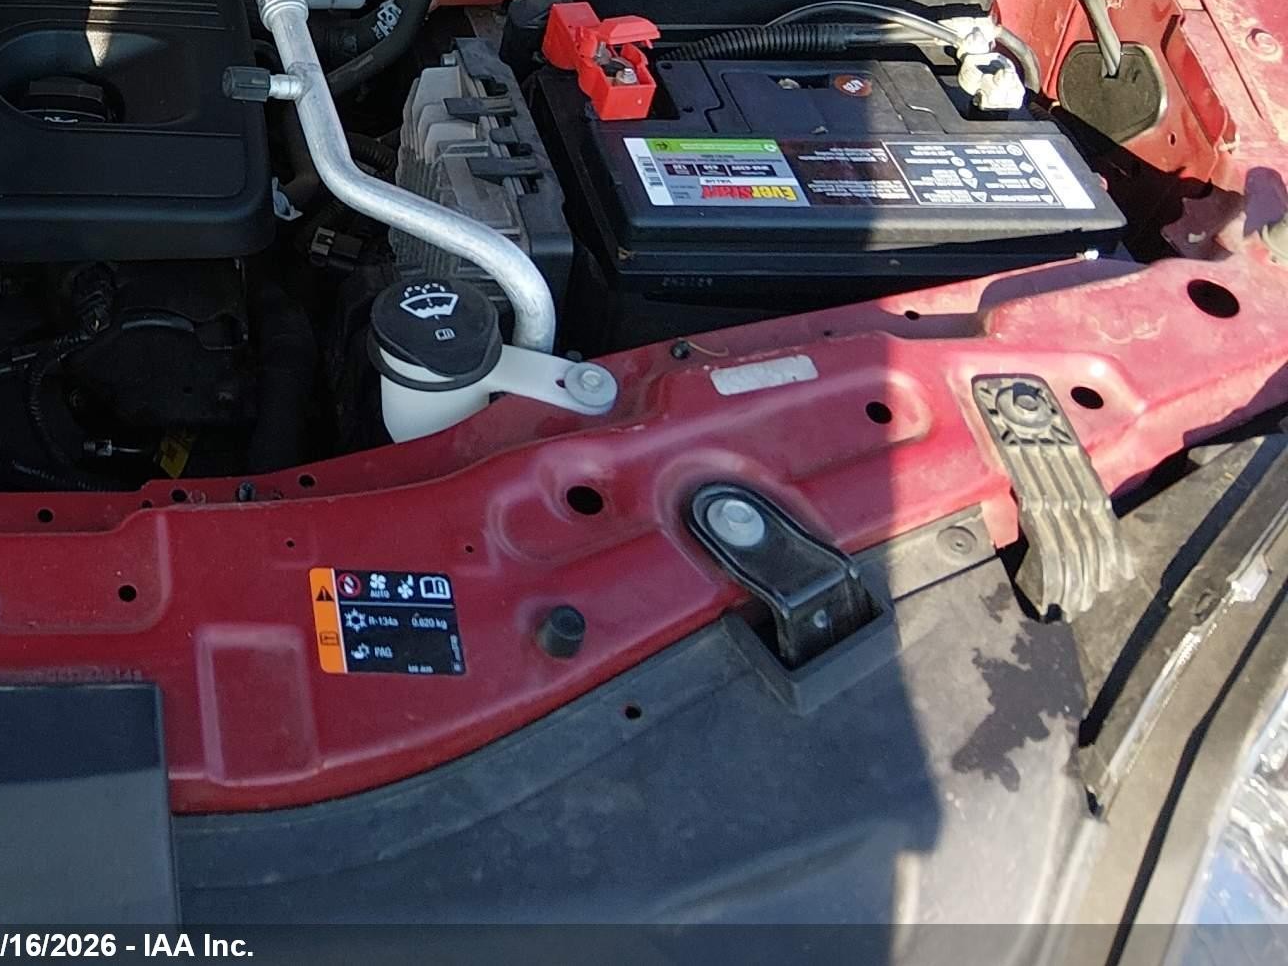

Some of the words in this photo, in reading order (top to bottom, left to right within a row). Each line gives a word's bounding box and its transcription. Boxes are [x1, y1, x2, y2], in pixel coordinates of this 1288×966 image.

[701, 185, 798, 202] EverStart
[370, 590, 391, 599] AUTO
[368, 616, 399, 627] R-134a
[435, 618, 448, 630] kg
[374, 647, 393, 658] PAG
